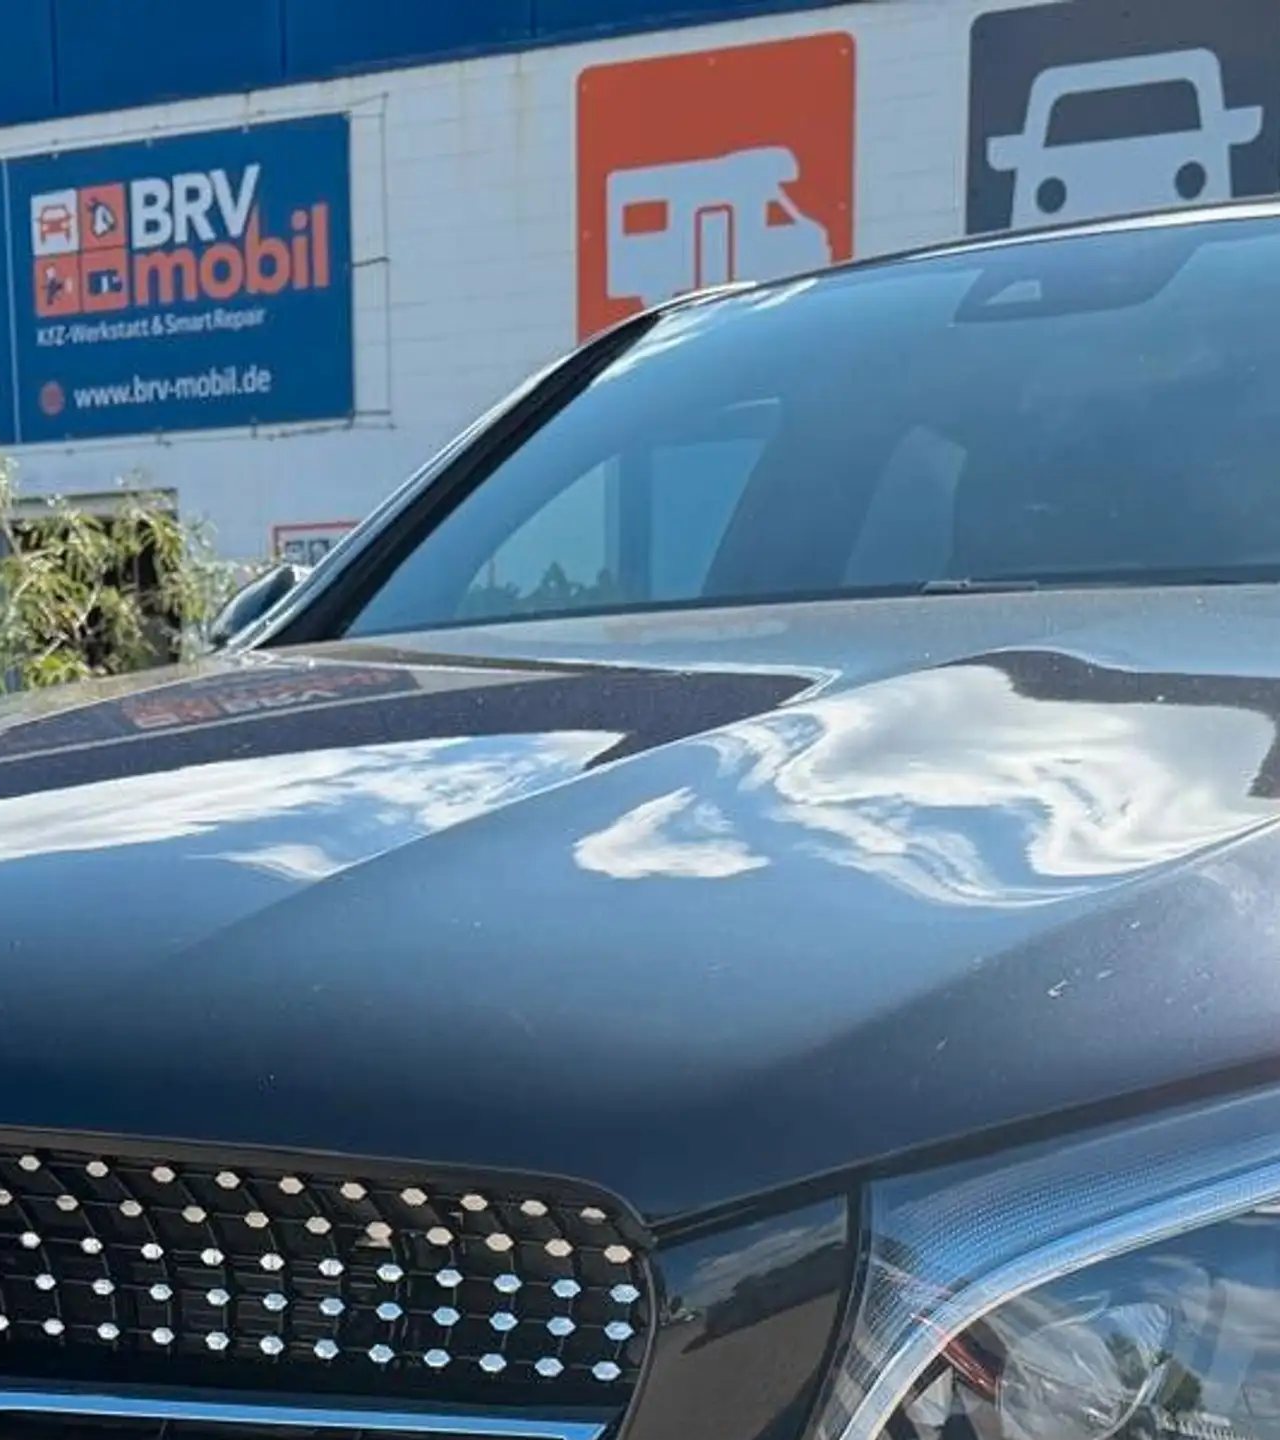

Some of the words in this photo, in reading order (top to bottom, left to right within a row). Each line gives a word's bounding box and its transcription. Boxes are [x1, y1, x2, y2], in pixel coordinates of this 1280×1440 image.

[130, 162, 261, 250] BRV
[134, 201, 330, 306] mobil
[151, 314, 164, 334] &
[165, 311, 213, 334] Smart
[72, 364, 272, 409] www.brv-mobil.de
